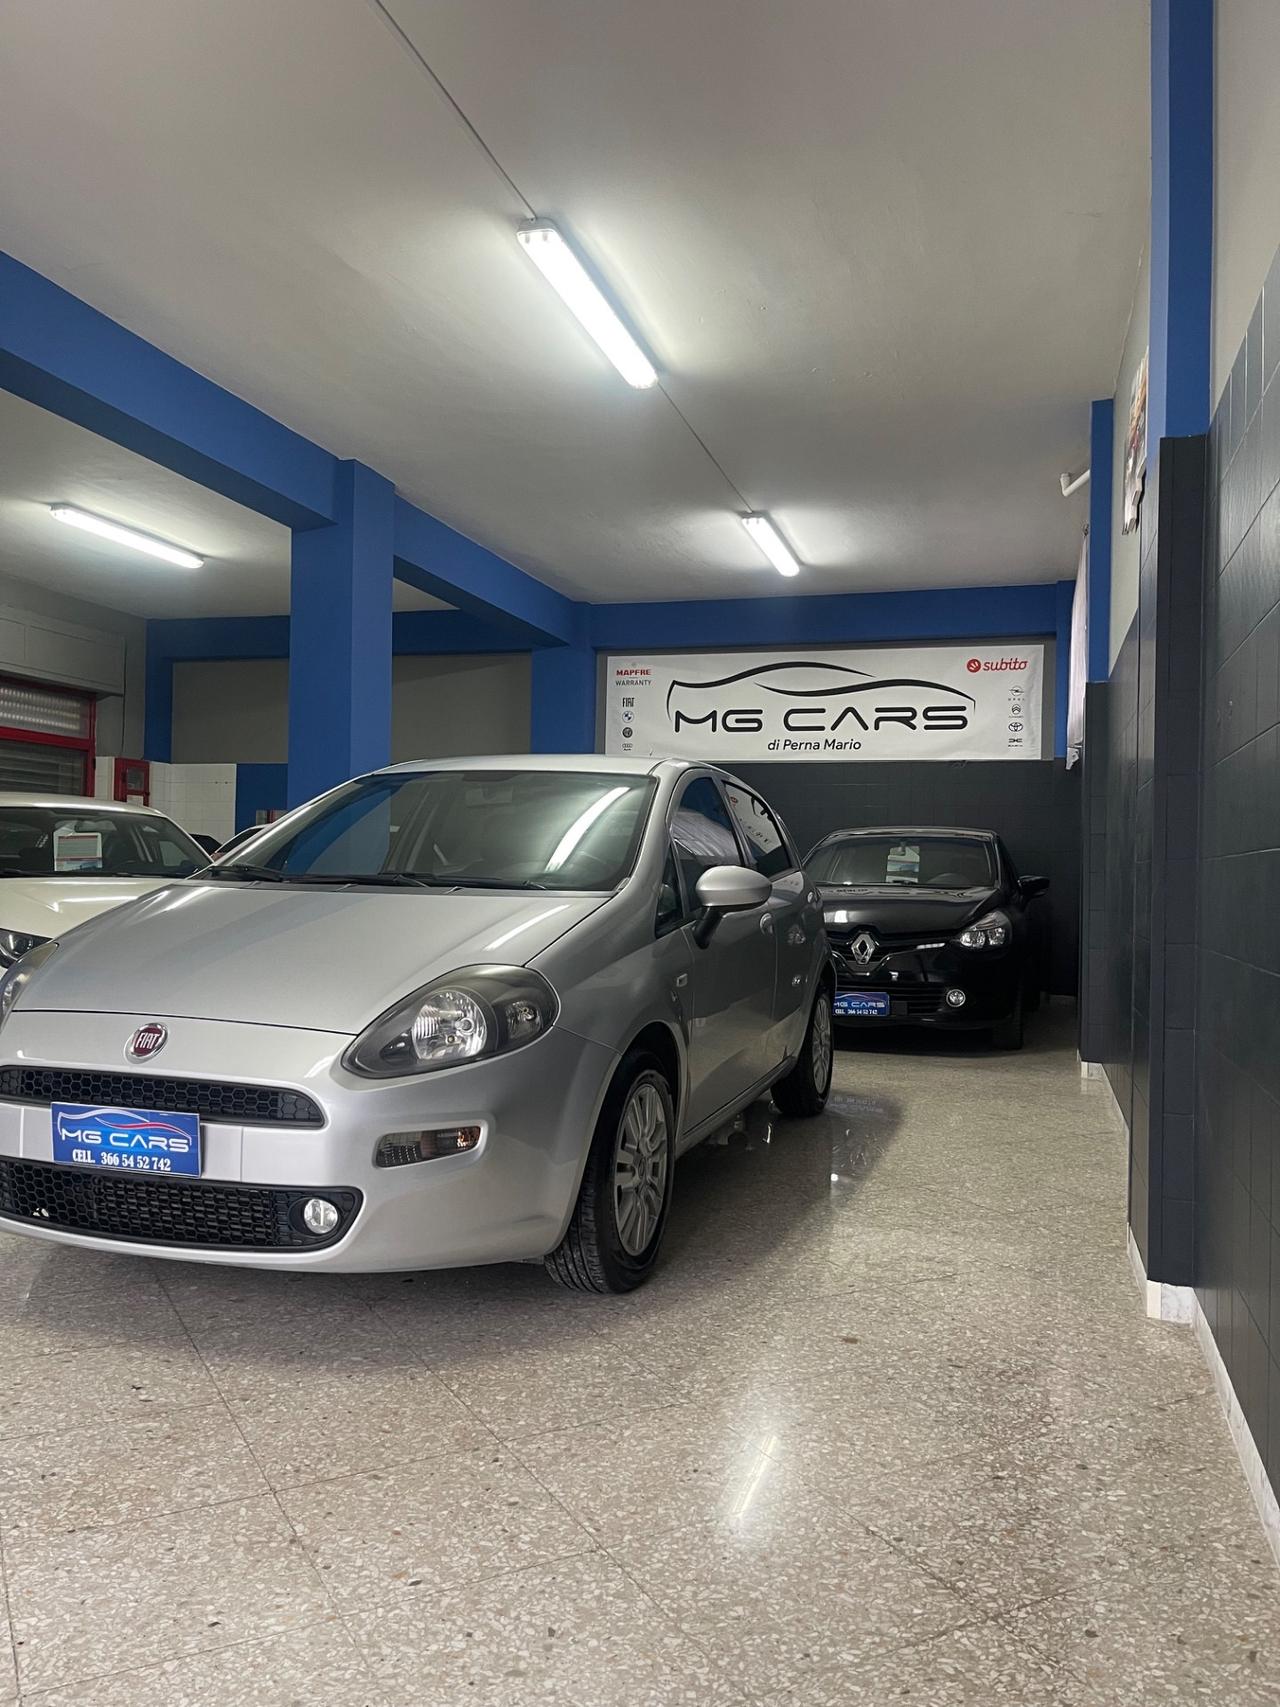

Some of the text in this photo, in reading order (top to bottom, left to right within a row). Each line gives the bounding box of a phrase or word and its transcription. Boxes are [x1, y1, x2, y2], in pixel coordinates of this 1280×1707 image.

[983, 658, 1027, 671] subito
[622, 698, 634, 707] FIAT
[675, 705, 968, 733] MG CARS
[767, 738, 862, 751] di Perna Mario
[135, 1032, 160, 1049] FIAT
[61, 1128, 189, 1153] MG CARS
[72, 1149, 171, 1171] CELL. 366 54 52 742
